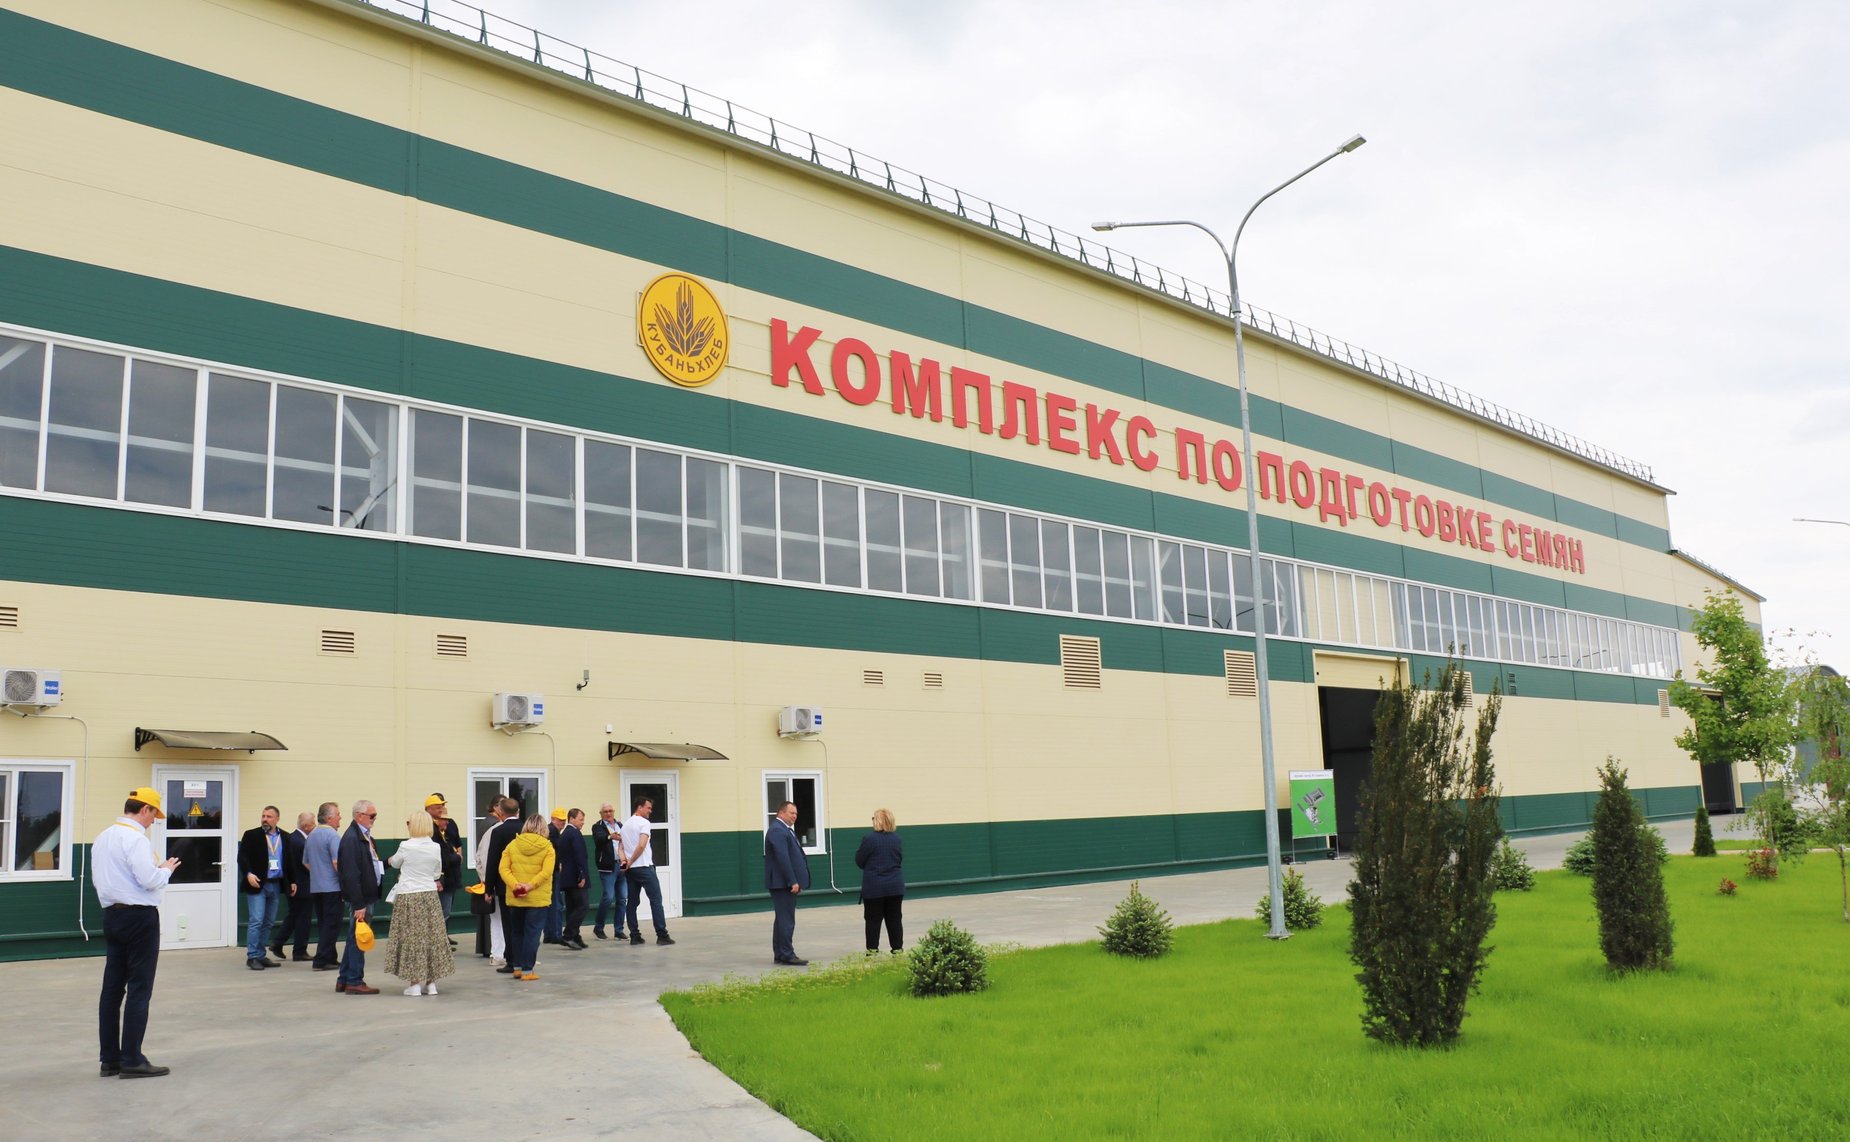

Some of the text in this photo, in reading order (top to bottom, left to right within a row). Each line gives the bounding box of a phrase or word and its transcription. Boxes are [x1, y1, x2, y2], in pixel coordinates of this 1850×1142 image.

[647, 322, 723, 373] КУБАНЬХЛЕБ
[770, 317, 1585, 574] КОМПЛЕКС ПО ПОДГОТОВКЕ СЕМЯН
